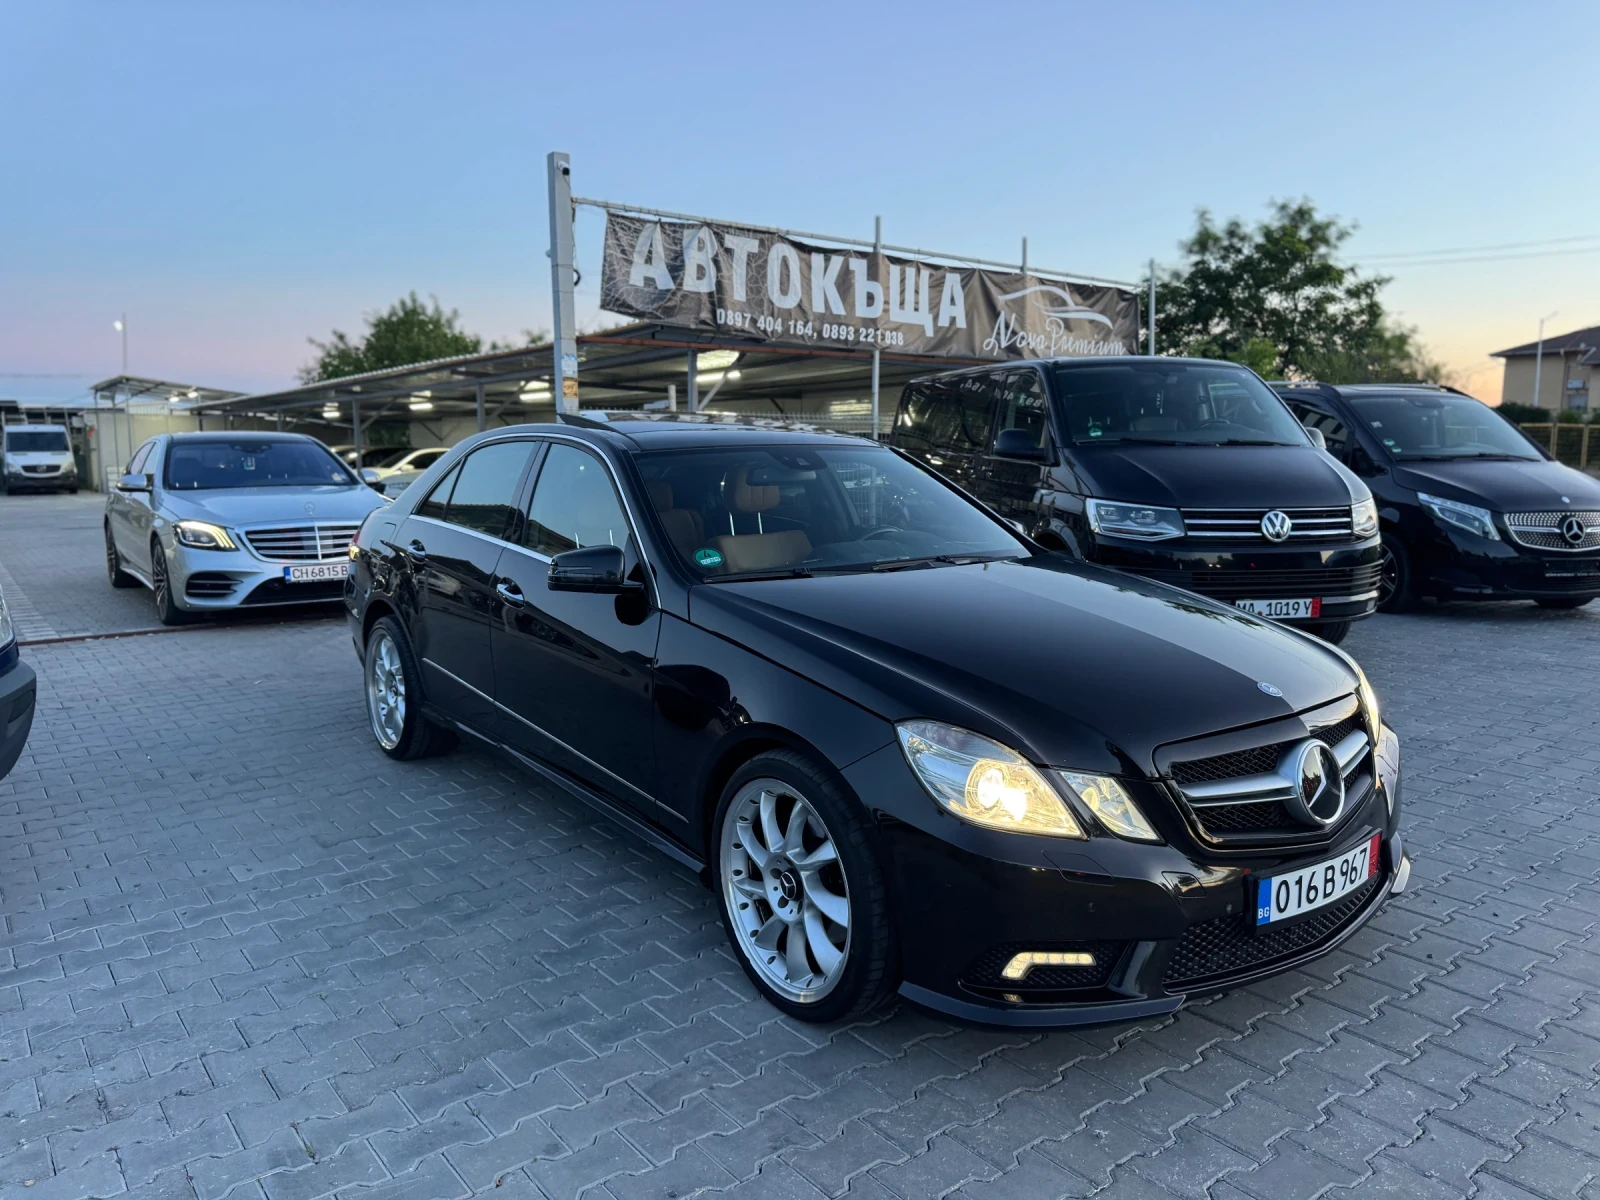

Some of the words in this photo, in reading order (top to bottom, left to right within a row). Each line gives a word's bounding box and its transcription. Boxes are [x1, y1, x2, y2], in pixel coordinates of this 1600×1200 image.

[629, 222, 966, 337] АВТОКЪЩА
[717, 308, 751, 326] 0897
[756, 318, 782, 333] 404
[788, 320, 817, 339] 164,
[823, 323, 854, 341] 0893
[859, 328, 881, 343] 221
[884, 333, 904, 346] 038
[983, 310, 1047, 356] Nova
[1046, 317, 1126, 356] Premium
[311, 566, 339, 578] 6815
[1265, 601, 1300, 617] 1019
[1257, 907, 1270, 919] BG
